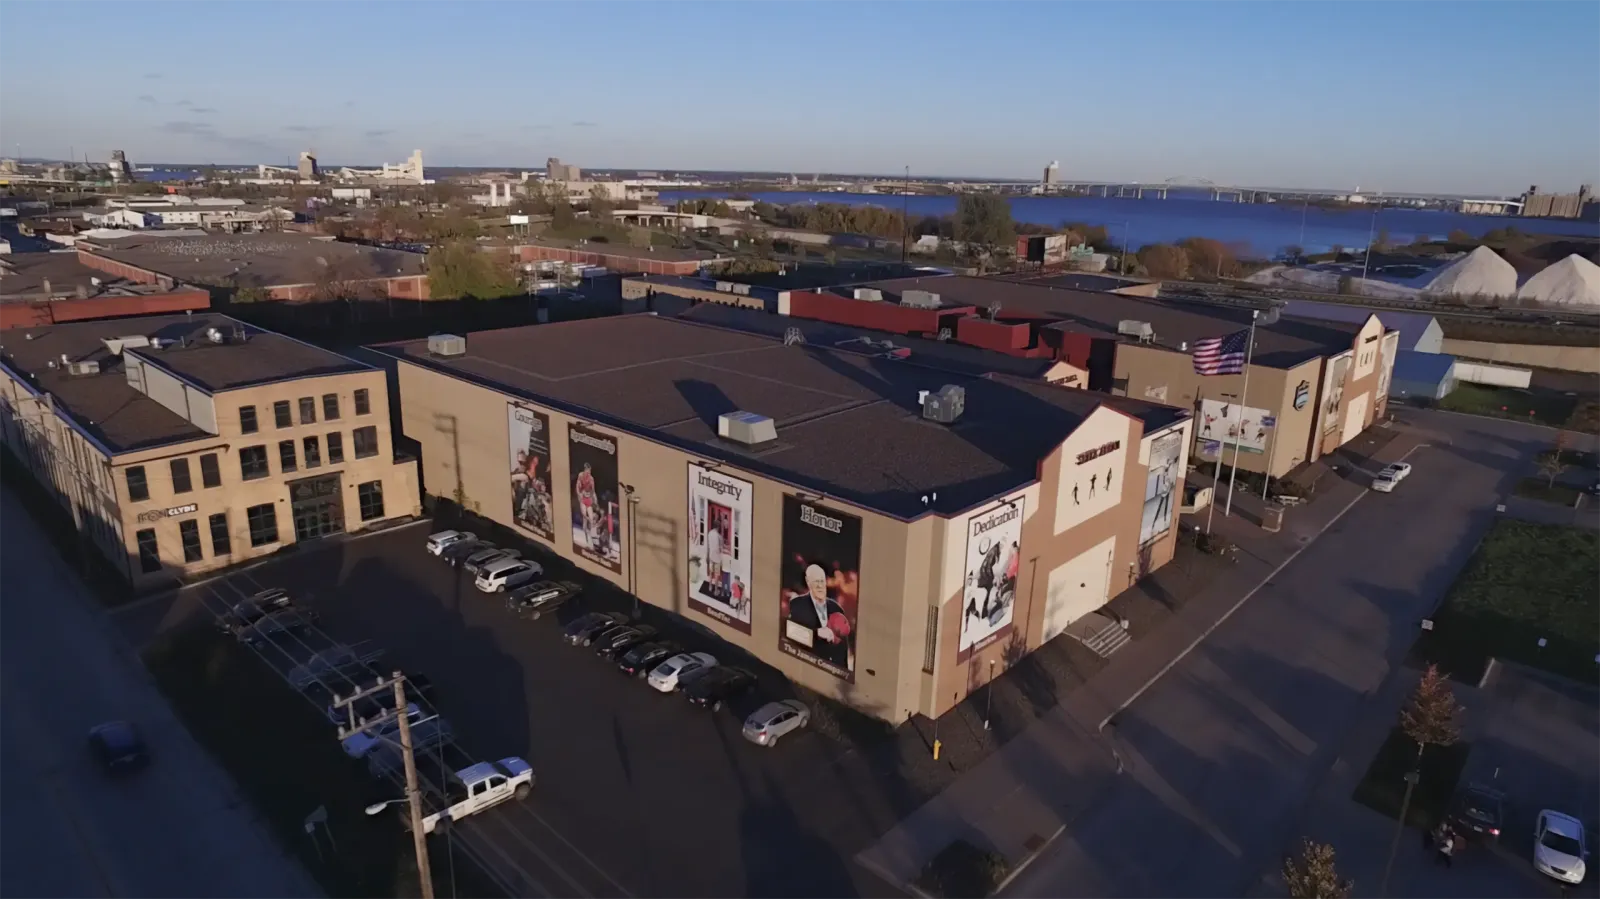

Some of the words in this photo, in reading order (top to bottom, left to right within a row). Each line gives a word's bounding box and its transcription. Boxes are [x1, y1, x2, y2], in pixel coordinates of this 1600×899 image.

[698, 472, 742, 501] Integrity
[801, 504, 842, 533] Honor
[974, 507, 1018, 536] Dedication
[784, 643, 796, 655] The
[818, 659, 849, 680] Company
